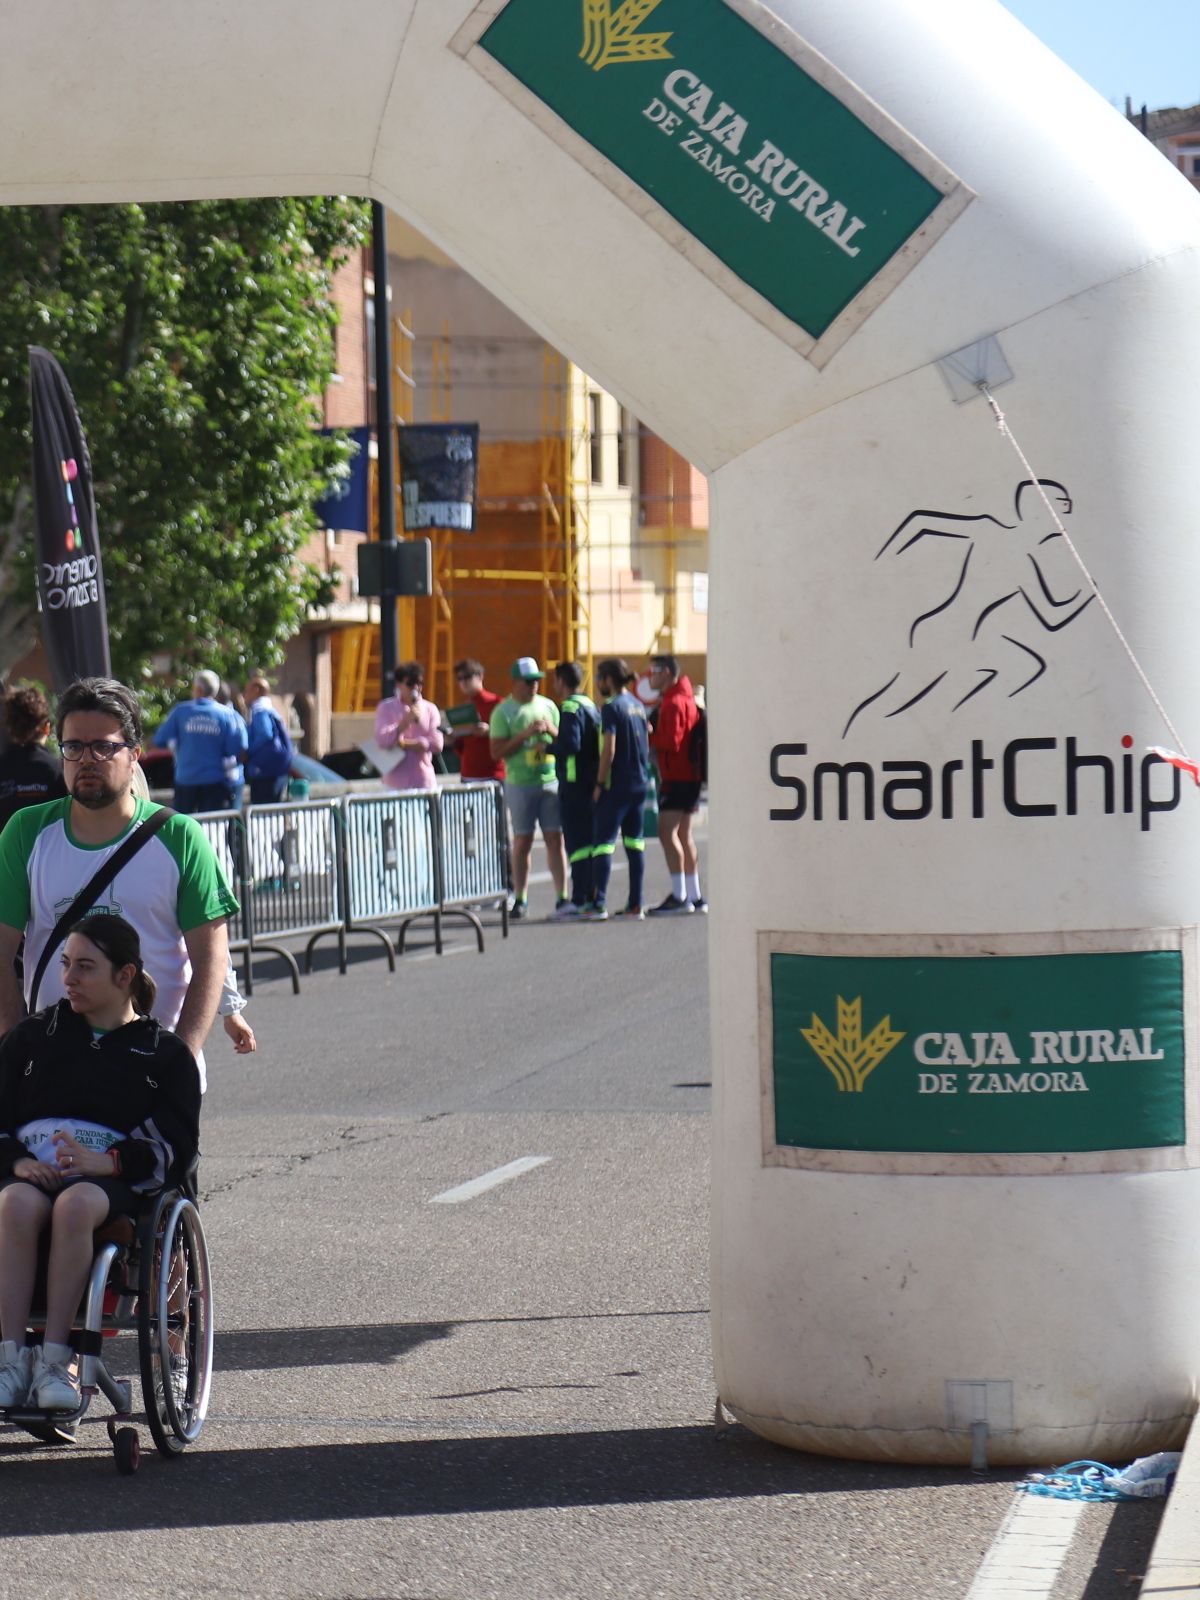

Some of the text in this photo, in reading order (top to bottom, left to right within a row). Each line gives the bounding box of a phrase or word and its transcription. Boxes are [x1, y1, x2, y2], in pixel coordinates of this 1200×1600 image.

[642, 97, 776, 222] DE ZAMORA
[663, 69, 866, 258] CAJA RURAL
[769, 734, 1182, 832] SmartChip
[914, 1027, 1165, 1068] CAJA RURAL
[918, 1071, 1090, 1094] DE ZAMORA
